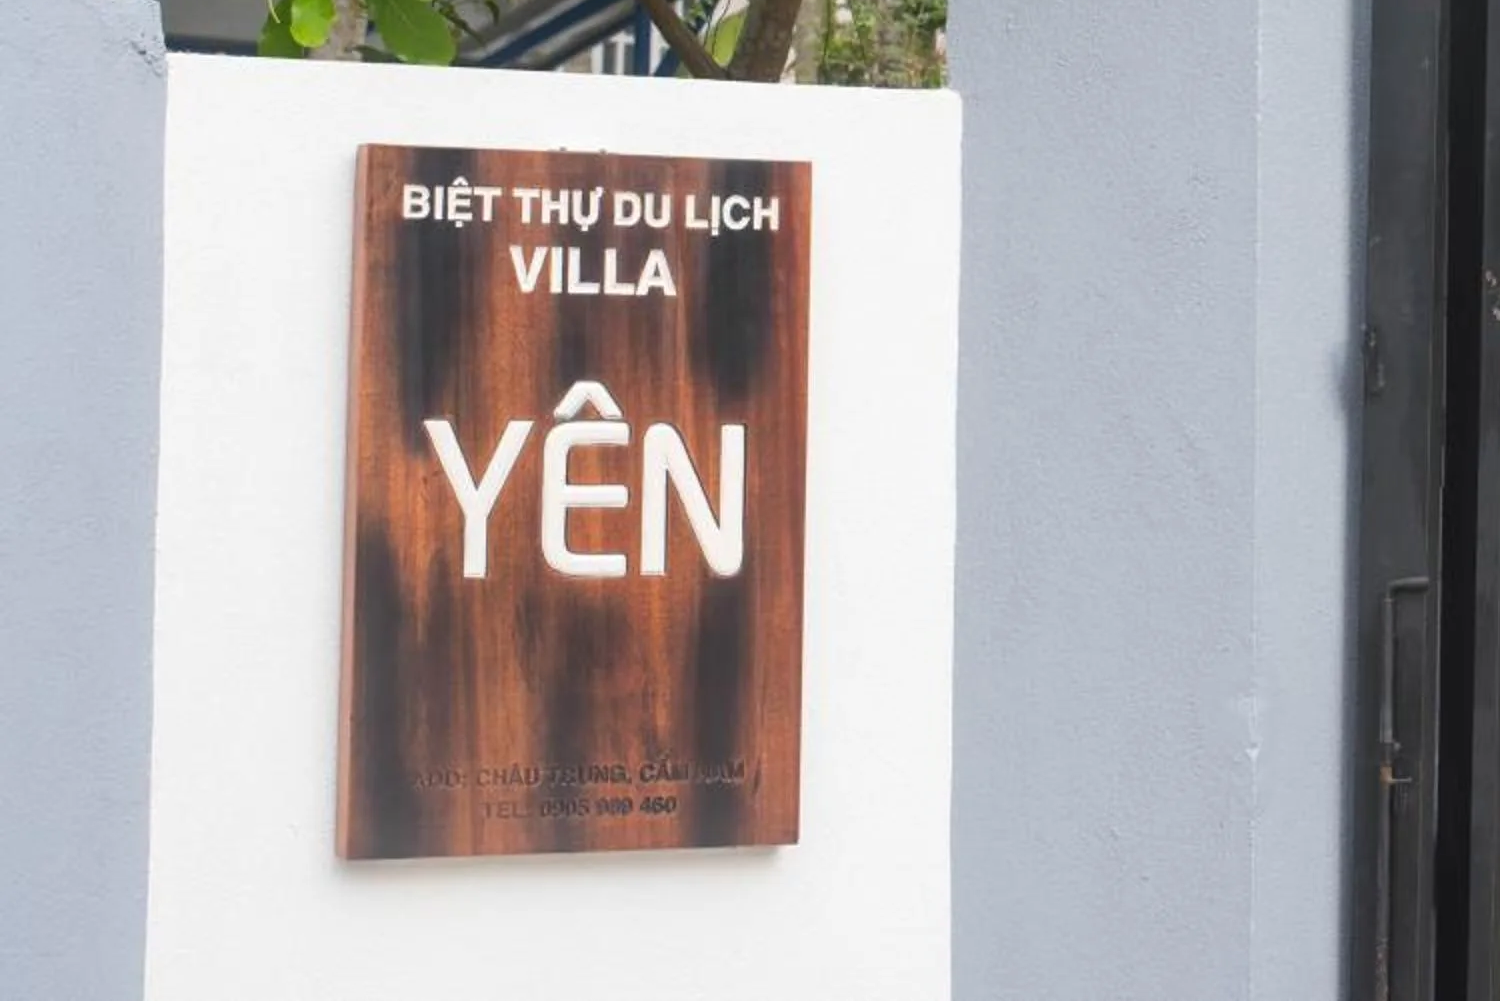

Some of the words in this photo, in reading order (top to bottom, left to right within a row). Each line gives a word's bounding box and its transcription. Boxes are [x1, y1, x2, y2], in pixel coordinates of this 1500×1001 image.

[402, 176, 501, 228] BIỆT
[513, 185, 604, 232] THỰ
[613, 192, 673, 228] DU
[684, 194, 780, 236] LỊCH
[509, 245, 677, 297] VILLA
[422, 380, 747, 579] YÊN
